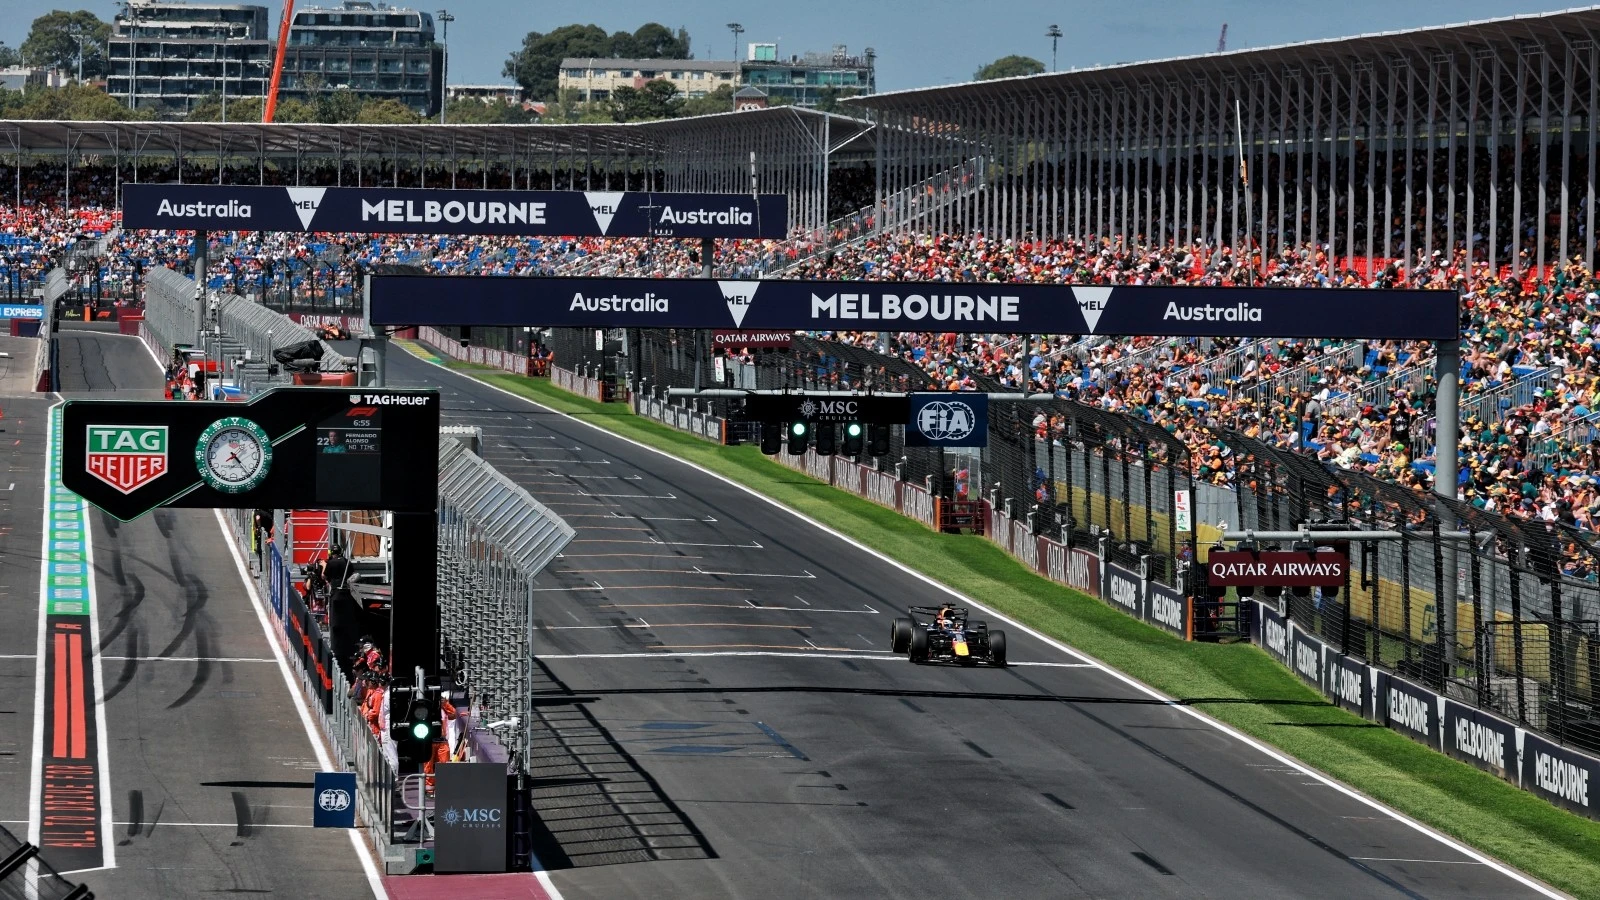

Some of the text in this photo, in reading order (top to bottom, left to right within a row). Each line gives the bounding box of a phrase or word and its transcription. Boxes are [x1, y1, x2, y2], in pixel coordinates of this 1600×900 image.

[157, 199, 251, 218] Australia
[294, 200, 319, 210] MEL
[362, 200, 546, 224] MELBOURNE
[591, 205, 616, 215] MEL
[660, 206, 752, 225] Australia
[569, 293, 669, 313] Australia
[725, 295, 750, 305] MEL
[811, 293, 1020, 321] MELBOURNE
[1079, 301, 1104, 311] MEL
[4, 307, 42, 316] EXPRESS
[1163, 302, 1262, 322] Australia
[716, 332, 790, 343] QATAR AIRWAYS
[820, 401, 858, 414] MSC
[94, 430, 160, 450] TAG
[91, 457, 162, 488] HEUER
[1047, 543, 1065, 583] QATAR
[1212, 562, 1341, 578] QATAR AIRWAYS
[1386, 686, 1428, 735] MELBOURNE
[1455, 716, 1505, 769] MELBOURNE
[1535, 750, 1588, 807] MELBOURNE
[463, 808, 501, 821] MSC
